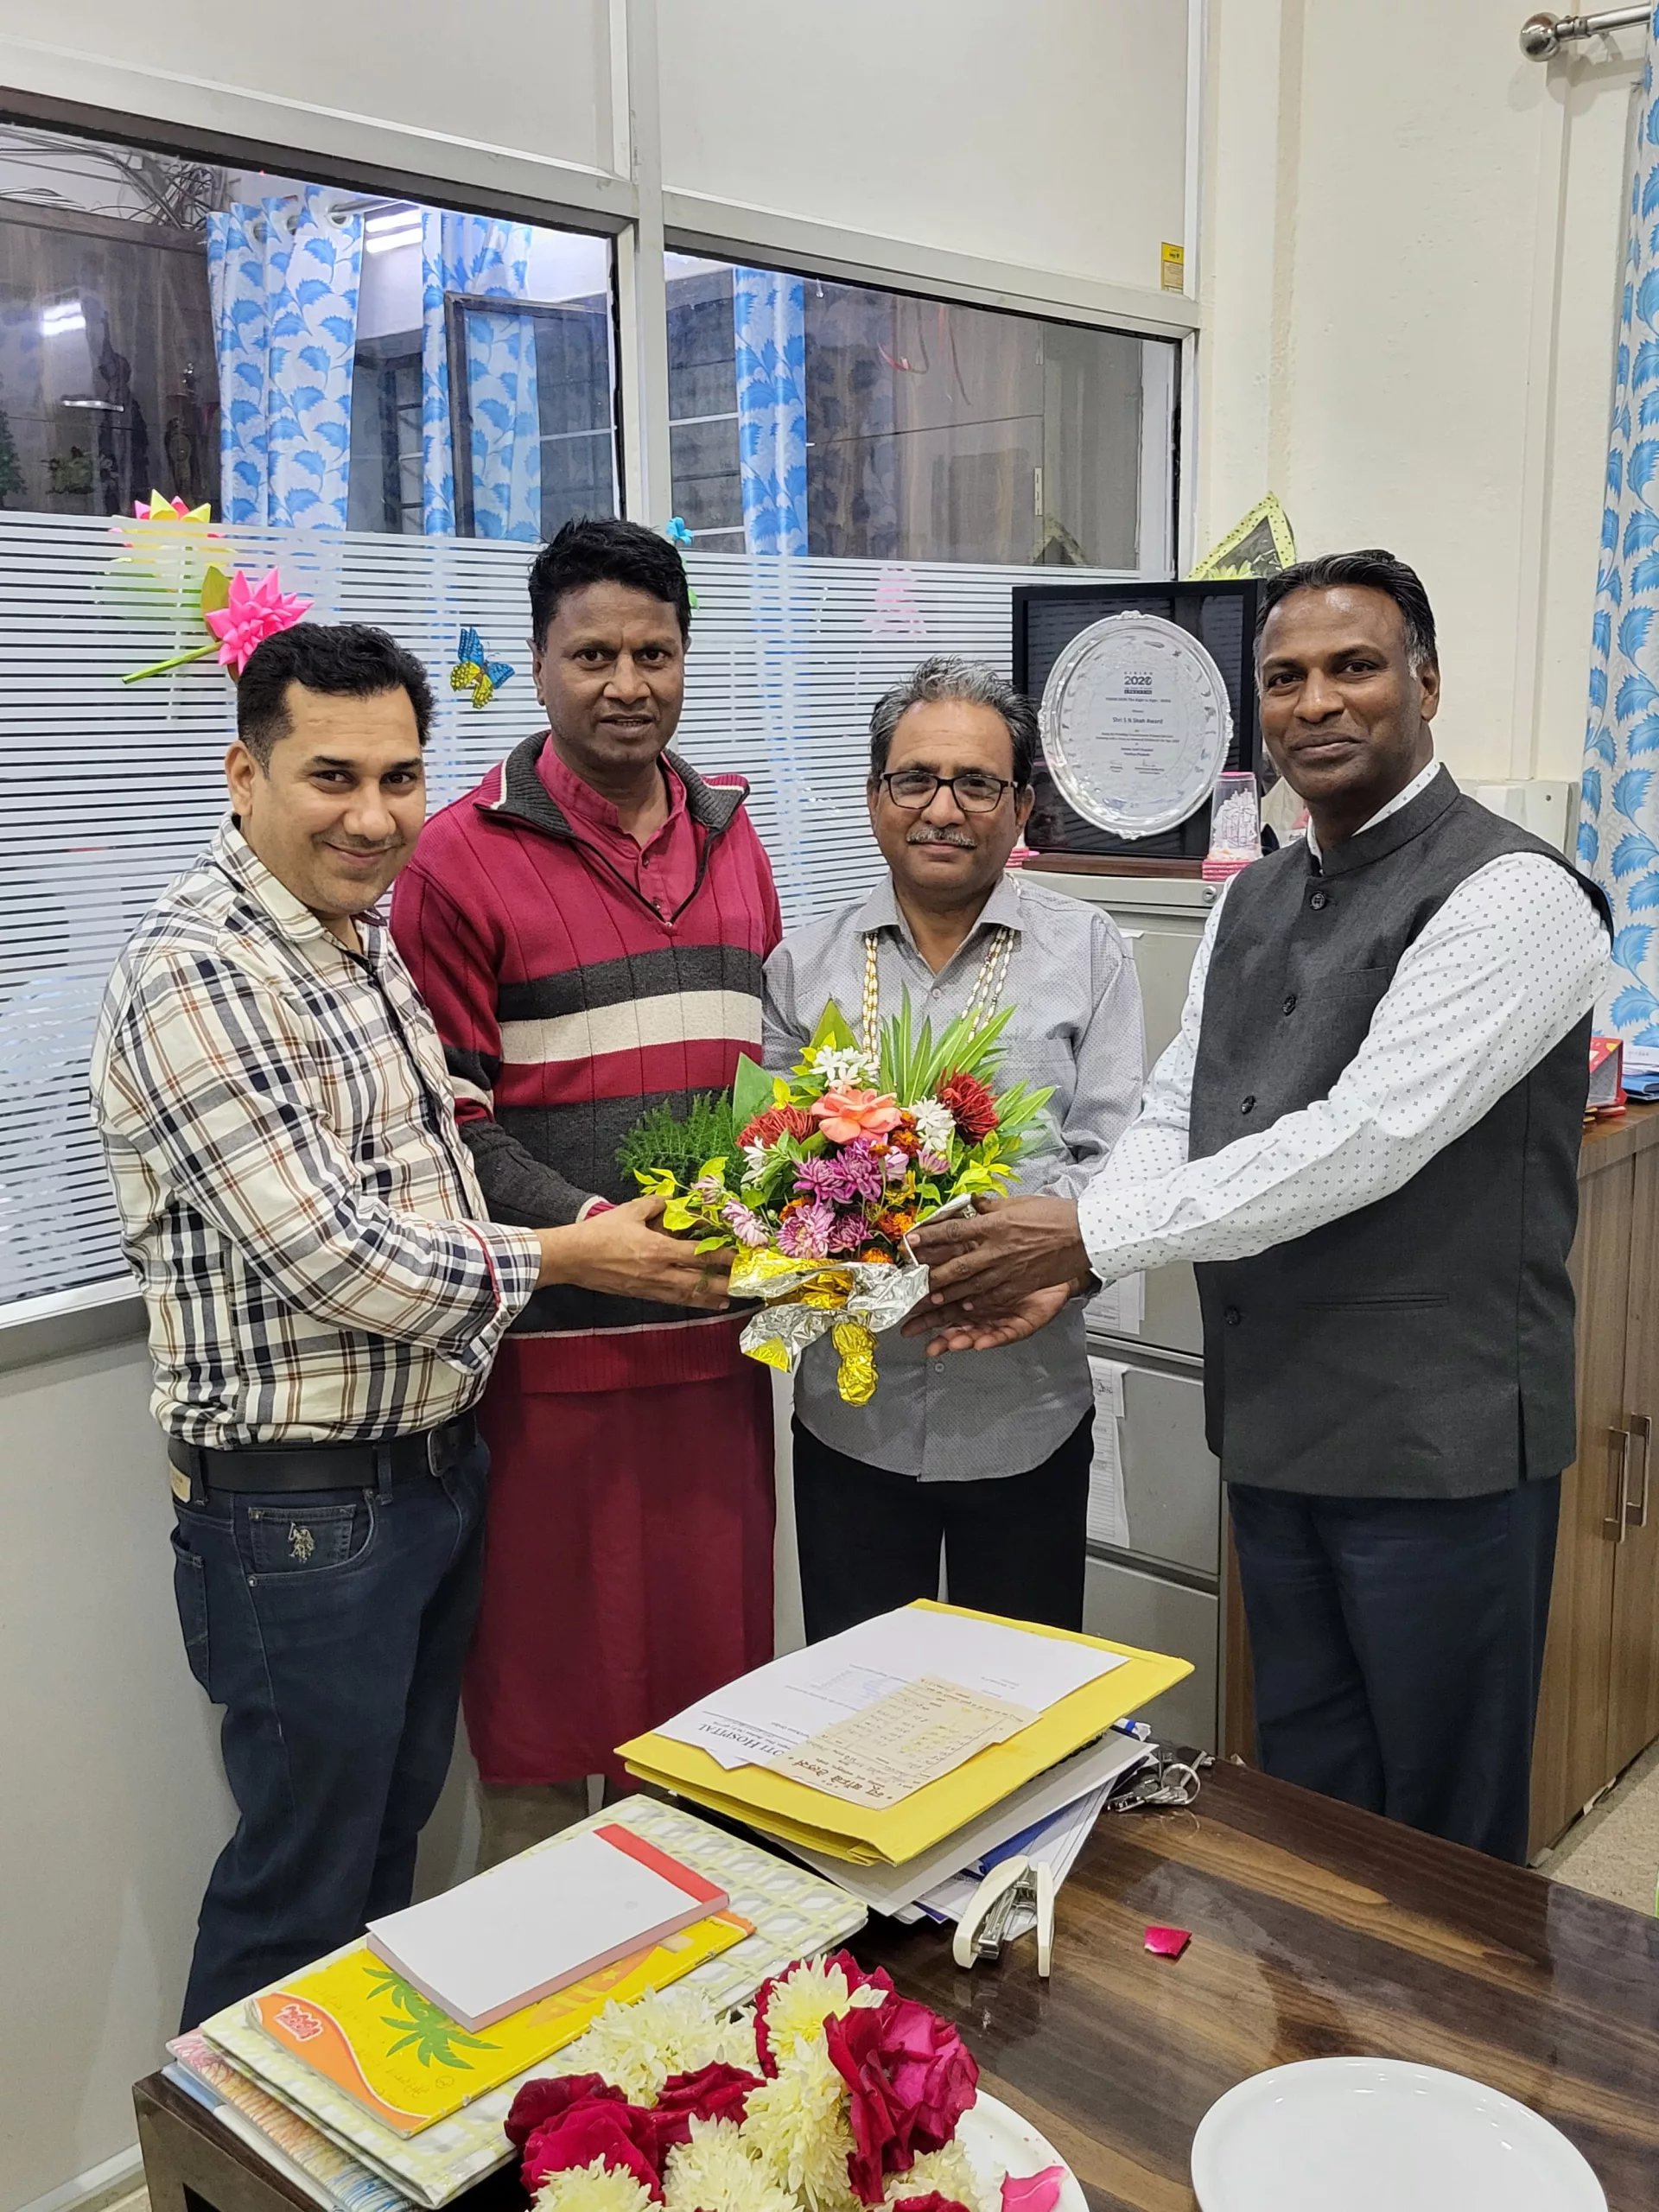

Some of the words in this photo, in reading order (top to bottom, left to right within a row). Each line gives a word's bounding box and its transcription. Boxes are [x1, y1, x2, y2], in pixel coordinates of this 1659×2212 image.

[1124, 676, 1152, 685] 2020
[791, 1759, 829, 1777] टेलर्स
[866, 1783, 885, 1798] न्यू
